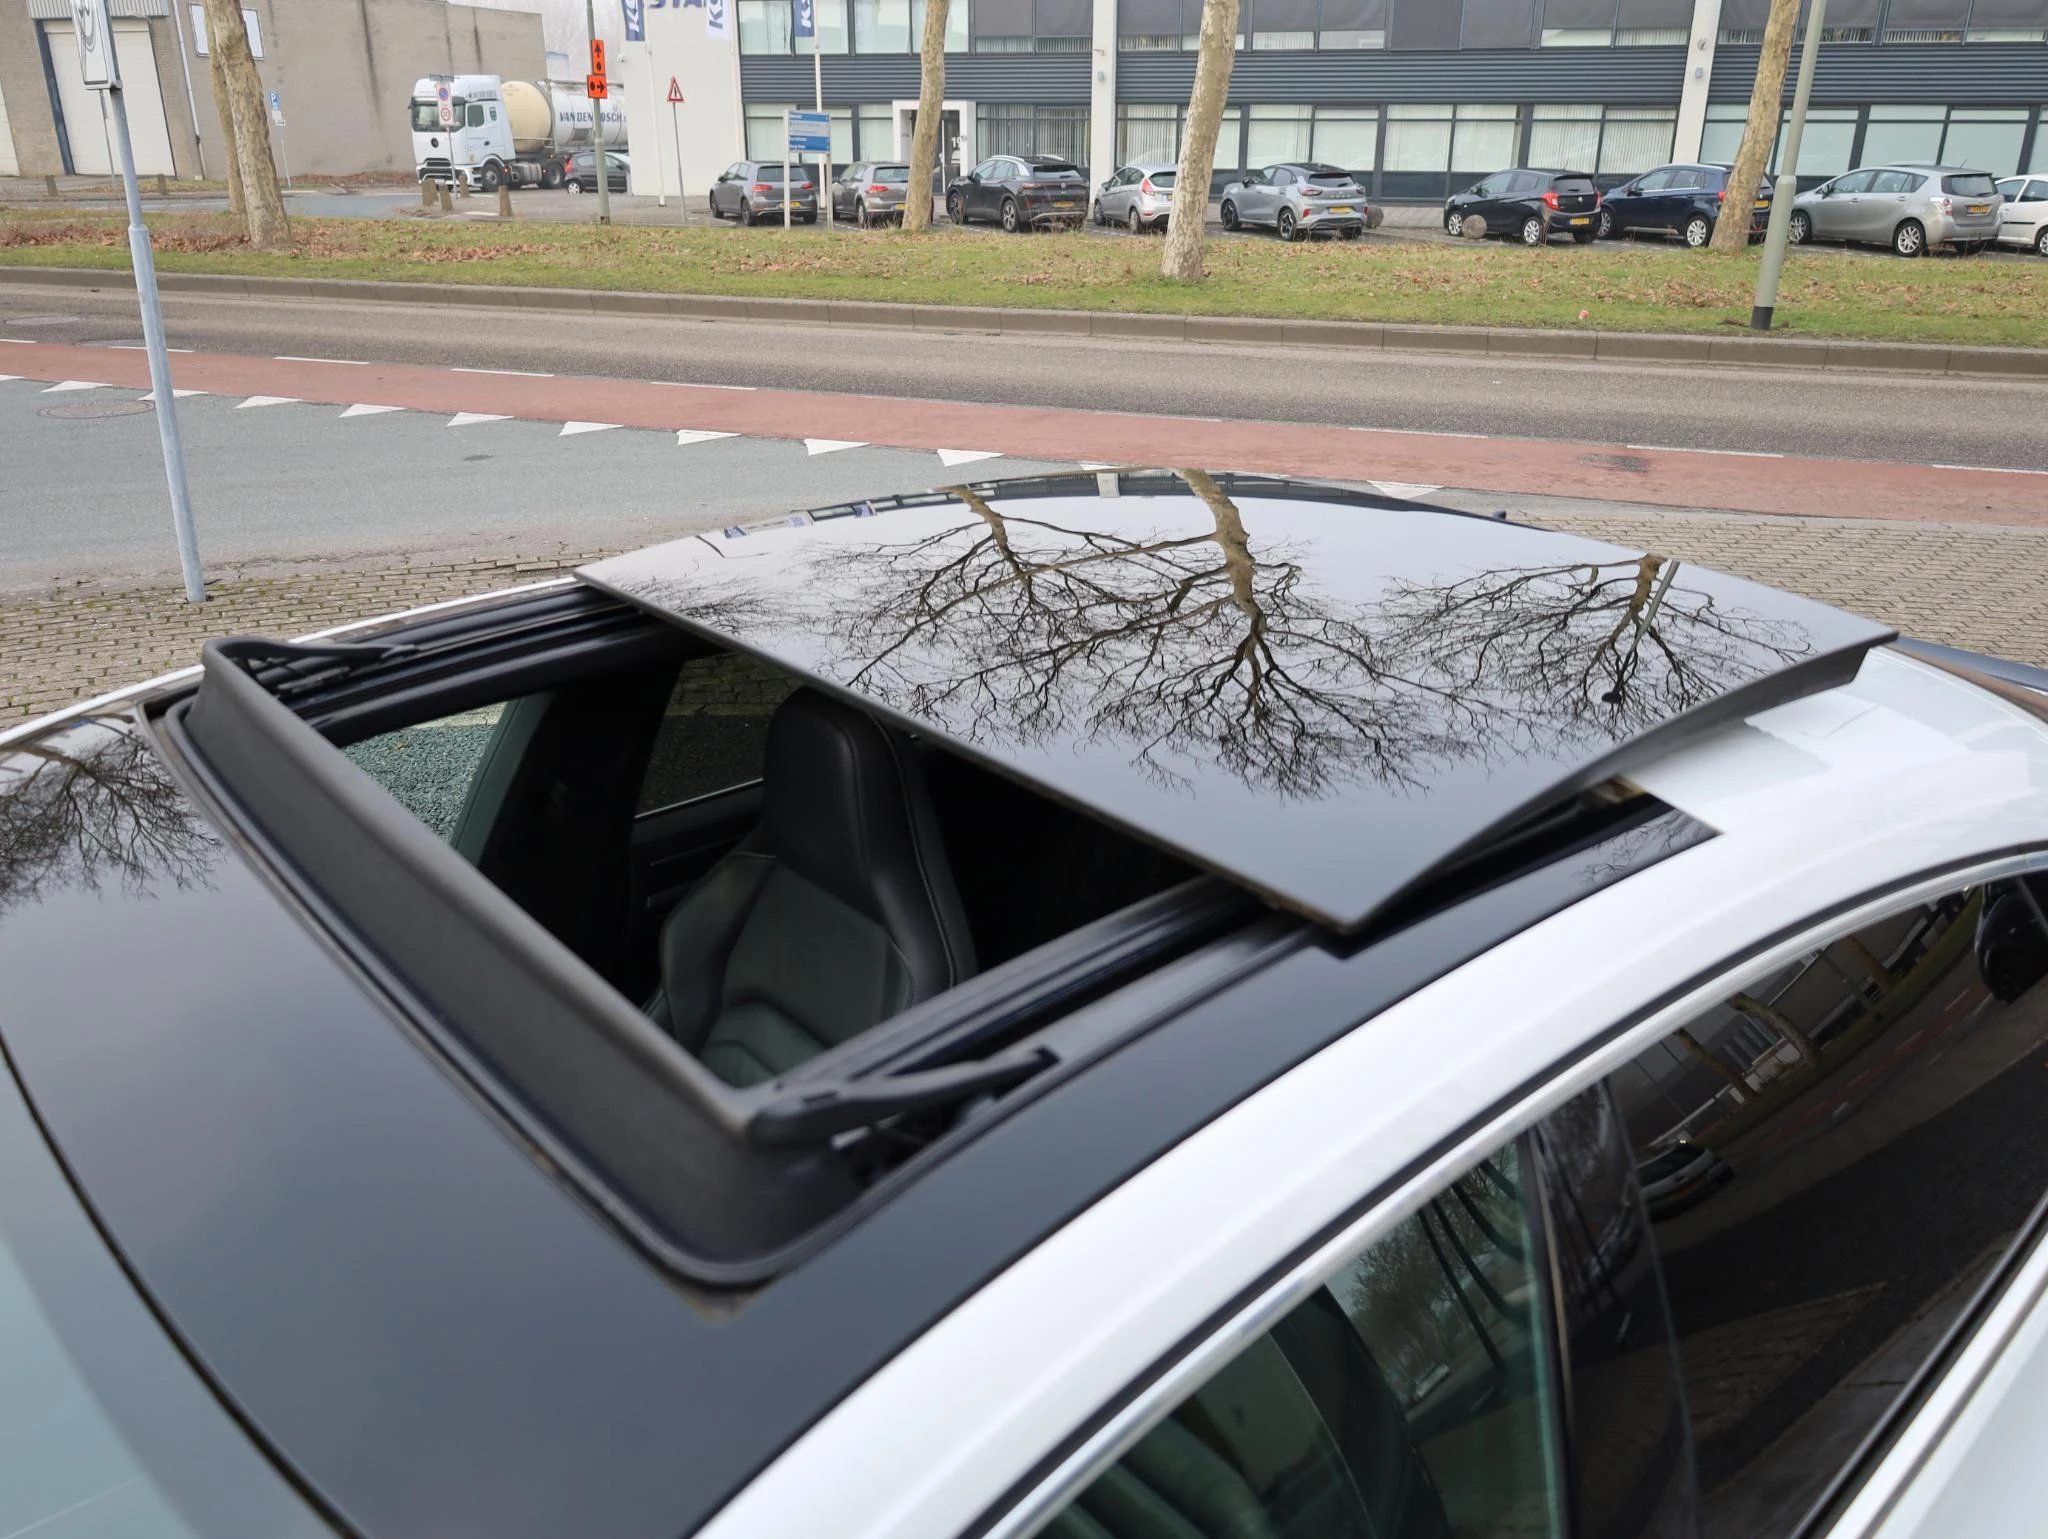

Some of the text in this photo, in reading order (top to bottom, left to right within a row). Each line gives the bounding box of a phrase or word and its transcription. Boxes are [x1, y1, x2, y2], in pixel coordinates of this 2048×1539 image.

[560, 112, 575, 122] VAN
[577, 112, 593, 122] DEN
[600, 112, 622, 122] OSCH
